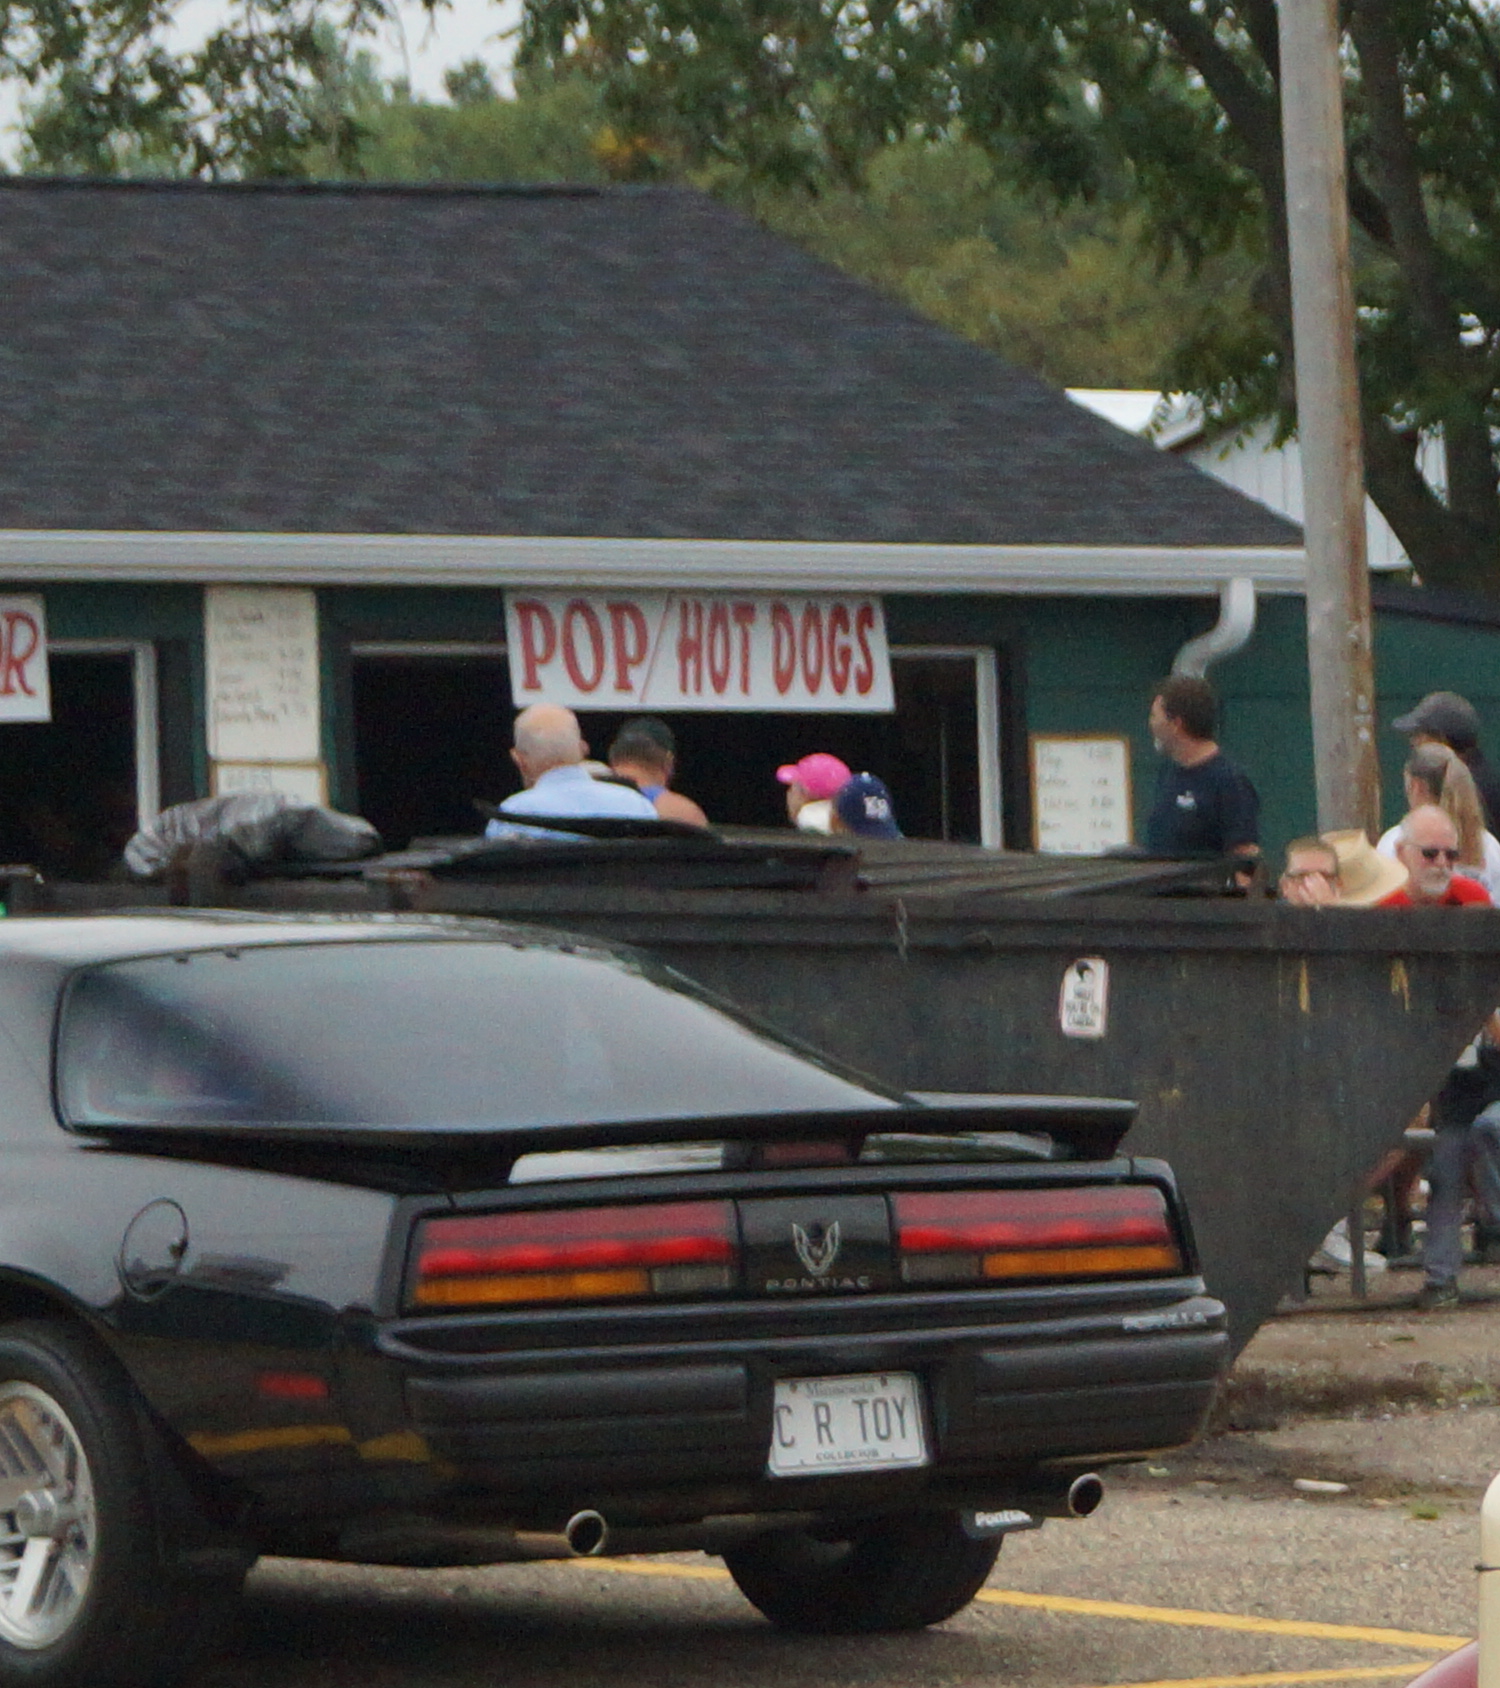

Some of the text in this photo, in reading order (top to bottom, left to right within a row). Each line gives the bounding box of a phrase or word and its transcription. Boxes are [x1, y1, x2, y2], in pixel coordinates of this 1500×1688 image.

[0, 609, 38, 696] R
[770, 602, 875, 695] DOGS
[766, 1275, 870, 1293] PONTIAC
[806, 1380, 876, 1397] Minnesota
[774, 1396, 907, 1448] C R TOY
